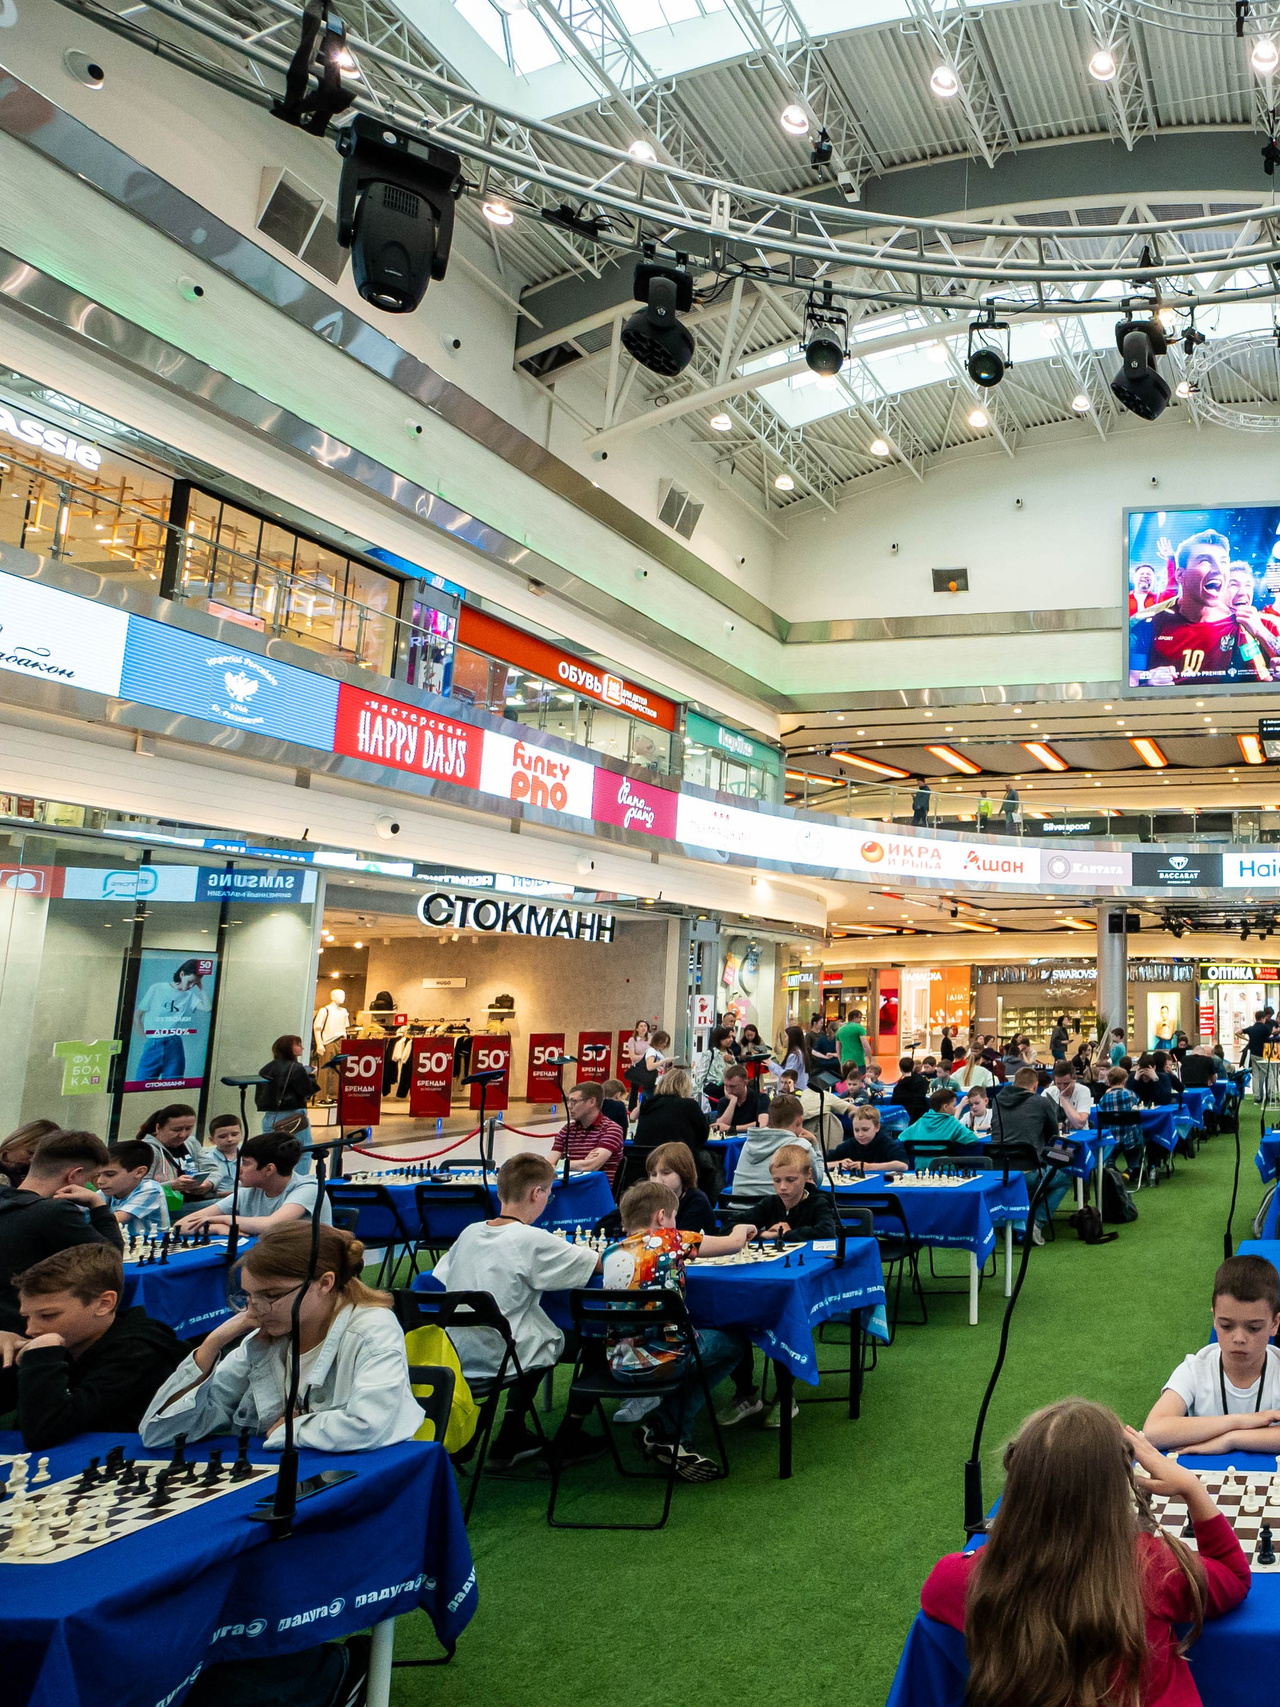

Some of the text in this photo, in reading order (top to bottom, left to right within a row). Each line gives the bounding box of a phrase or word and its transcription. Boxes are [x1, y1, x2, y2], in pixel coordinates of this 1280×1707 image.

[558, 660, 602, 694] ОБУВЬ
[370, 700, 463, 736] мастерская
[357, 710, 467, 779] HAPPY DAYS
[888, 843, 942, 861] ИКРА
[901, 859, 942, 871] РЫБА
[417, 892, 616, 943] СТОКМАНН
[1052, 969, 1098, 980] SWAROVS
[1207, 966, 1254, 980] ОПТИКА
[73, 1053, 102, 1063] ФУТ
[345, 1055, 382, 1078] 50%
[417, 1052, 453, 1074] 50%
[477, 1049, 510, 1069] 50%
[72, 1066, 101, 1076] БОЛ
[344, 1085, 375, 1093] БРЕНДЫ
[277, 1605, 329, 1632] радуга
[354, 1579, 415, 1608] радуга
